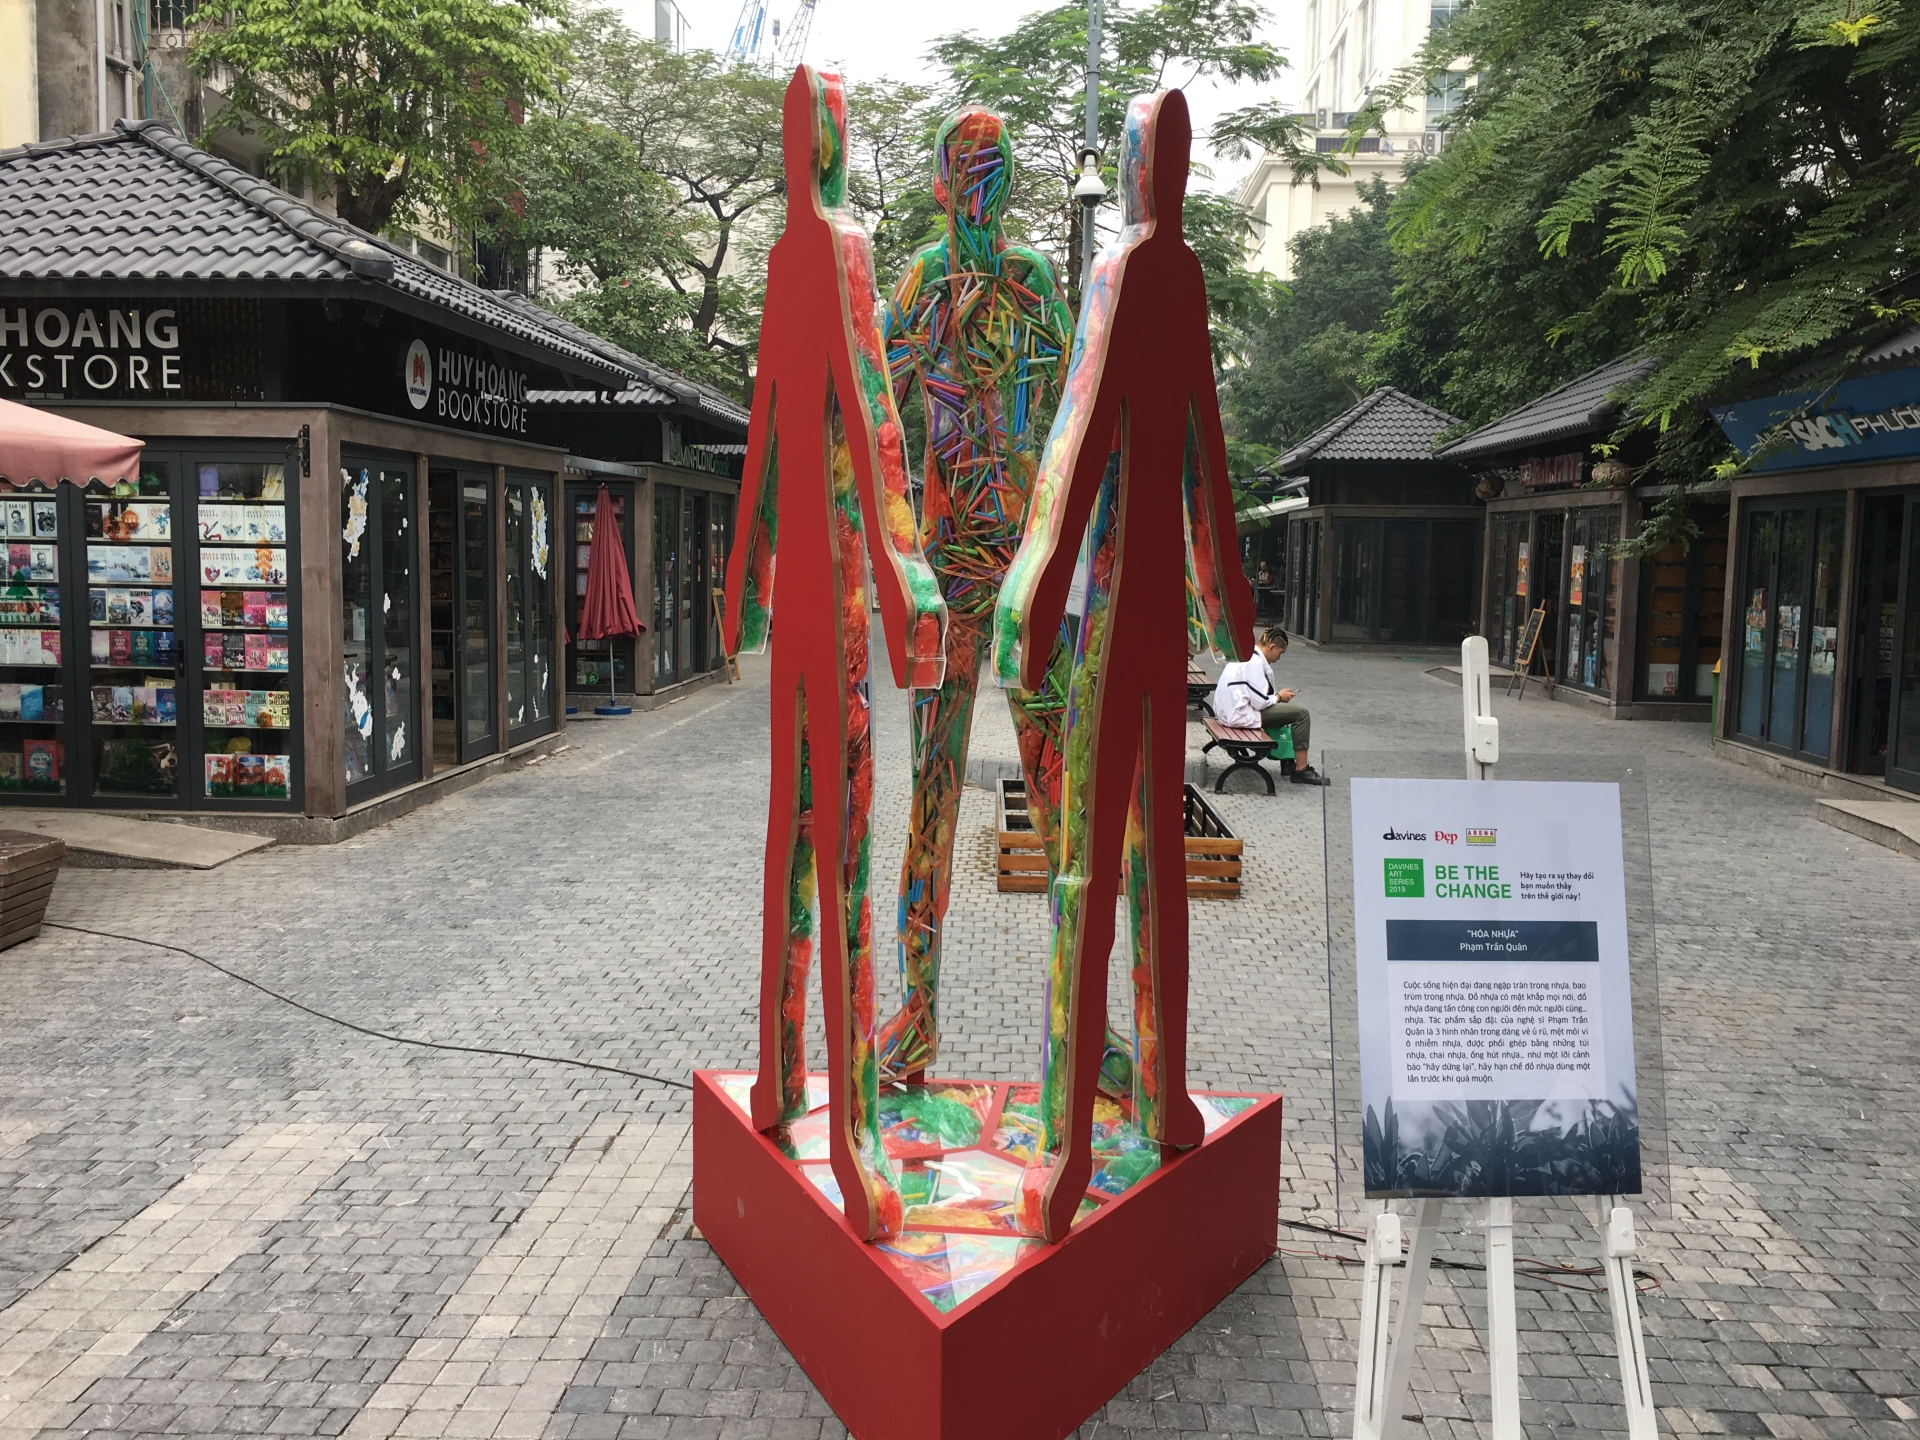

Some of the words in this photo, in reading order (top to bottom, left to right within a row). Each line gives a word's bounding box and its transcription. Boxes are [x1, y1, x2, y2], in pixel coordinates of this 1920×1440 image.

[438, 387, 528, 433] BOOKSTORE
[1790, 410, 1862, 451] SÁCH
[1382, 826, 1426, 841] davines
[1434, 831, 1458, 845] Đẹp
[1388, 863, 1419, 871] DAVINES
[1435, 865, 1459, 880] BE
[1464, 865, 1499, 880] THE
[1520, 872, 1533, 881] Hãy
[1535, 872, 1547, 880] tạo
[1566, 872, 1581, 881] thay
[1583, 871, 1594, 880] đổi
[1389, 878, 1414, 886] SERIES
[1520, 882, 1533, 890] bạn
[1535, 881, 1555, 889] muốn
[1557, 881, 1572, 891] thấy
[1435, 883, 1512, 899] CHANGE
[1538, 891, 1549, 899] thế
[1551, 892, 1564, 901] giới
[1566, 893, 1581, 901] này!
[1460, 942, 1483, 953] Phạm
[1485, 942, 1504, 951] Trần
[1506, 943, 1527, 952] Quân
[1404, 981, 1421, 990] Cuộc
[1423, 981, 1440, 990] sống
[1442, 981, 1458, 990] hiện
[1460, 982, 1471, 990] đại
[1474, 982, 1492, 990] đang
[1494, 982, 1511, 990] ngập
[1530, 982, 1549, 990] trong
[1551, 982, 1571, 990] nhựa,
[1446, 993, 1466, 1001] nhựa.
[1468, 992, 1478, 1000] Đồ
[1480, 993, 1498, 1001] nhựa
[1511, 993, 1525, 1001] mặt
[1527, 993, 1544, 1001] khắp
[1547, 993, 1560, 1001] mọi
[1562, 993, 1575, 1001] nơi,
[1405, 1005, 1423, 1013] nhựa
[1424, 1005, 1442, 1013] đang
[1444, 1004, 1456, 1012] tấn
[1458, 1005, 1475, 1013] công
[1491, 1005, 1510, 1013] người
[1512, 1004, 1526, 1012] đến
[1544, 1004, 1564, 1013] người
[1405, 1016, 1425, 1025] nhựa.
[1445, 1015, 1465, 1024] phẩm
[1469, 1015, 1482, 1024] sắp
[1485, 1016, 1497, 1025] đặt
[1517, 1016, 1535, 1025] nghệ
[1548, 1016, 1568, 1025] Phạm
[1572, 1015, 1588, 1023] Trần
[1406, 1028, 1425, 1036] Quân
[1481, 1028, 1500, 1036] trong
[1502, 1028, 1520, 1036] dáng
[1522, 1027, 1530, 1035] vẻ
[1532, 1027, 1537, 1035] ủ
[1539, 1028, 1548, 1036] rũ,
[1550, 1028, 1564, 1036] mệt
[1566, 1027, 1579, 1035] mỏi
[1415, 1039, 1438, 1047] nhiễm
[1443, 1040, 1462, 1048] nhựa,
[1467, 1040, 1484, 1048] được
[1489, 1039, 1504, 1048] phối
[1509, 1039, 1527, 1048] ghép
[1531, 1039, 1549, 1048] bằng
[1553, 1039, 1575, 1048] những
[1407, 1052, 1426, 1060] nhựa,
[1430, 1051, 1444, 1059] chai
[1448, 1051, 1467, 1060] nhựa,
[1470, 1051, 1484, 1060] ống
[1544, 1051, 1558, 1059] một
[1407, 1063, 1421, 1071] báo
[1423, 1063, 1440, 1071] "hãy
[1442, 1063, 1461, 1071] dừng
[1463, 1063, 1476, 1071] lại",
[1478, 1063, 1492, 1071] hãy
[1494, 1063, 1508, 1071] hạn
[1510, 1062, 1522, 1070] chế
[1525, 1062, 1534, 1070] đồ
[1536, 1063, 1554, 1071] nhựa
[1556, 1062, 1574, 1071] dùng
[1576, 1062, 1590, 1071] một
[1408, 1074, 1419, 1082] lần
[1456, 1075, 1469, 1083] quá
[1472, 1075, 1494, 1083] muộn.
